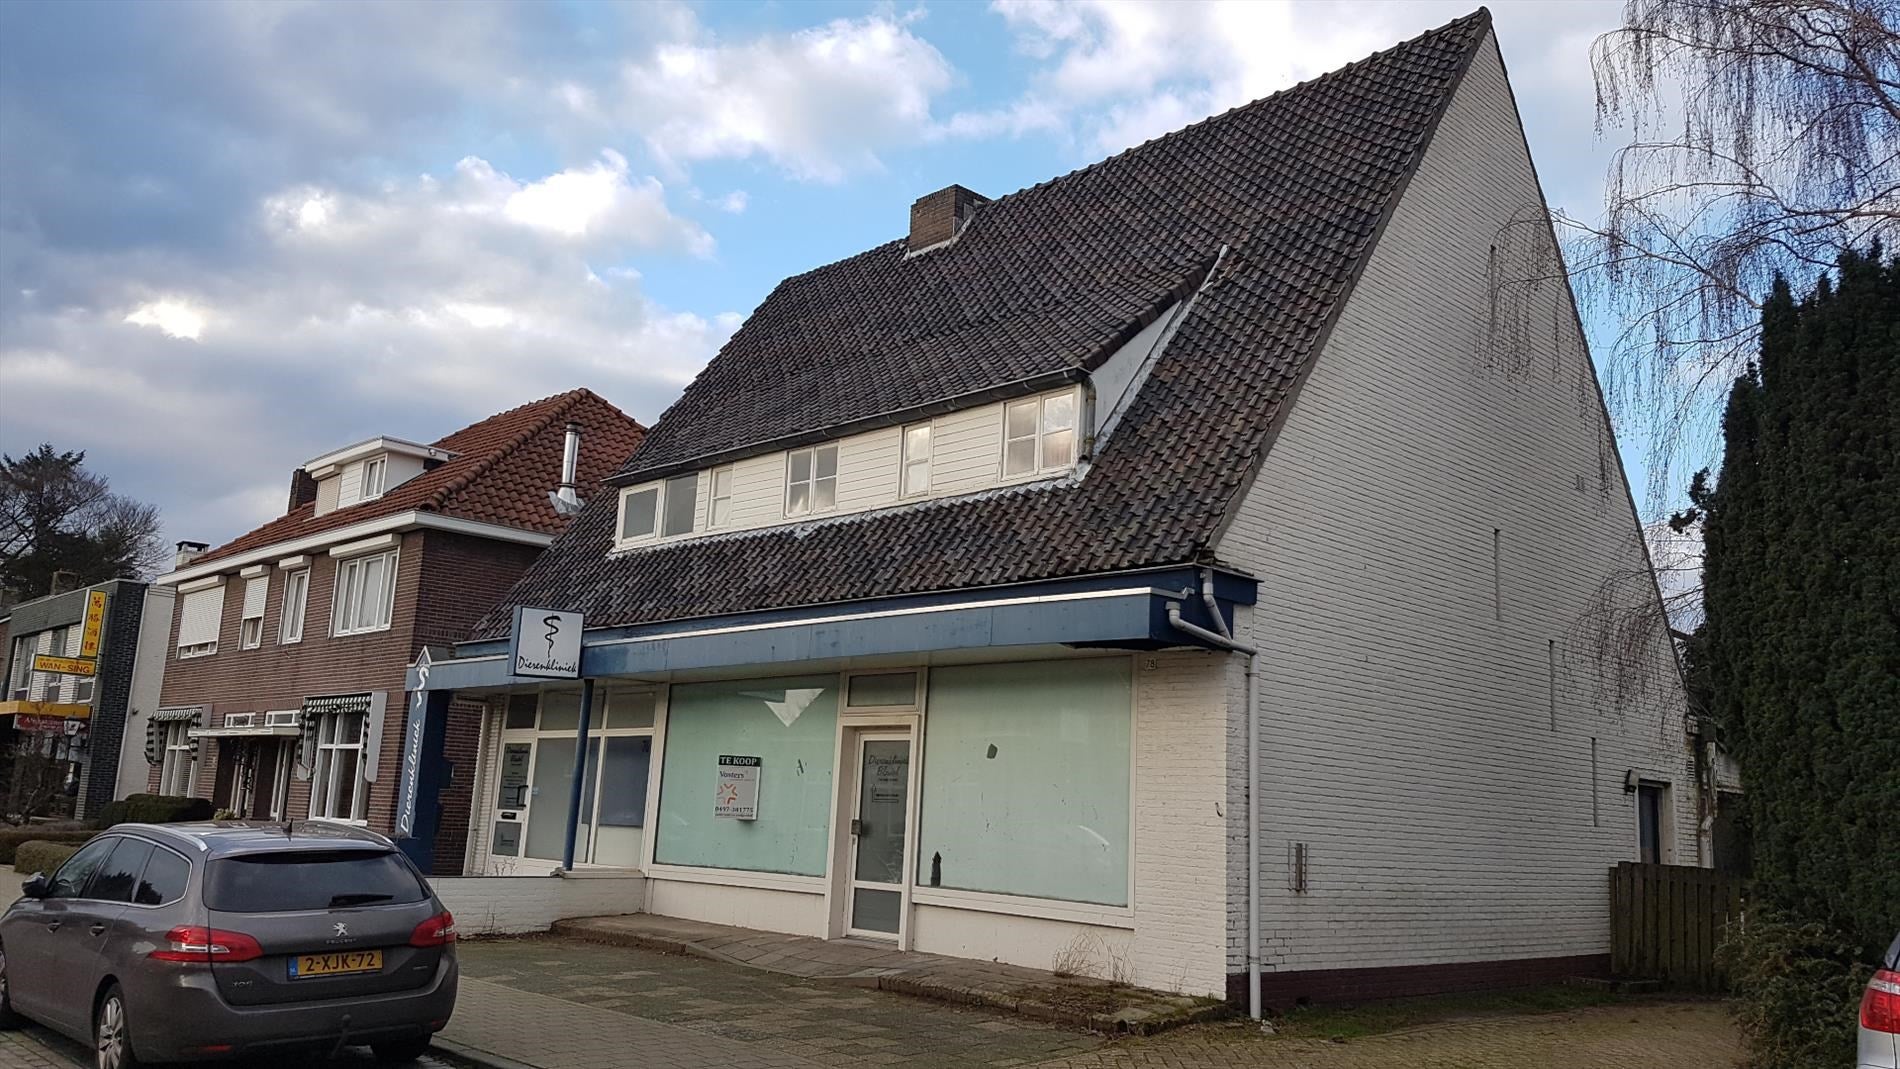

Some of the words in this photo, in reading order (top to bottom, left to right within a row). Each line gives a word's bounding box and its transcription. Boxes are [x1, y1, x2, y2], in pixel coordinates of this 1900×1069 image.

[39, 661, 90, 673] WAN-SING
[518, 655, 577, 674] Dierenkliniek
[719, 756, 732, 764] TE
[733, 757, 757, 766] KOOP
[400, 719, 421, 833] Dierenkliniek
[305, 952, 375, 972] 2-XJK-72
